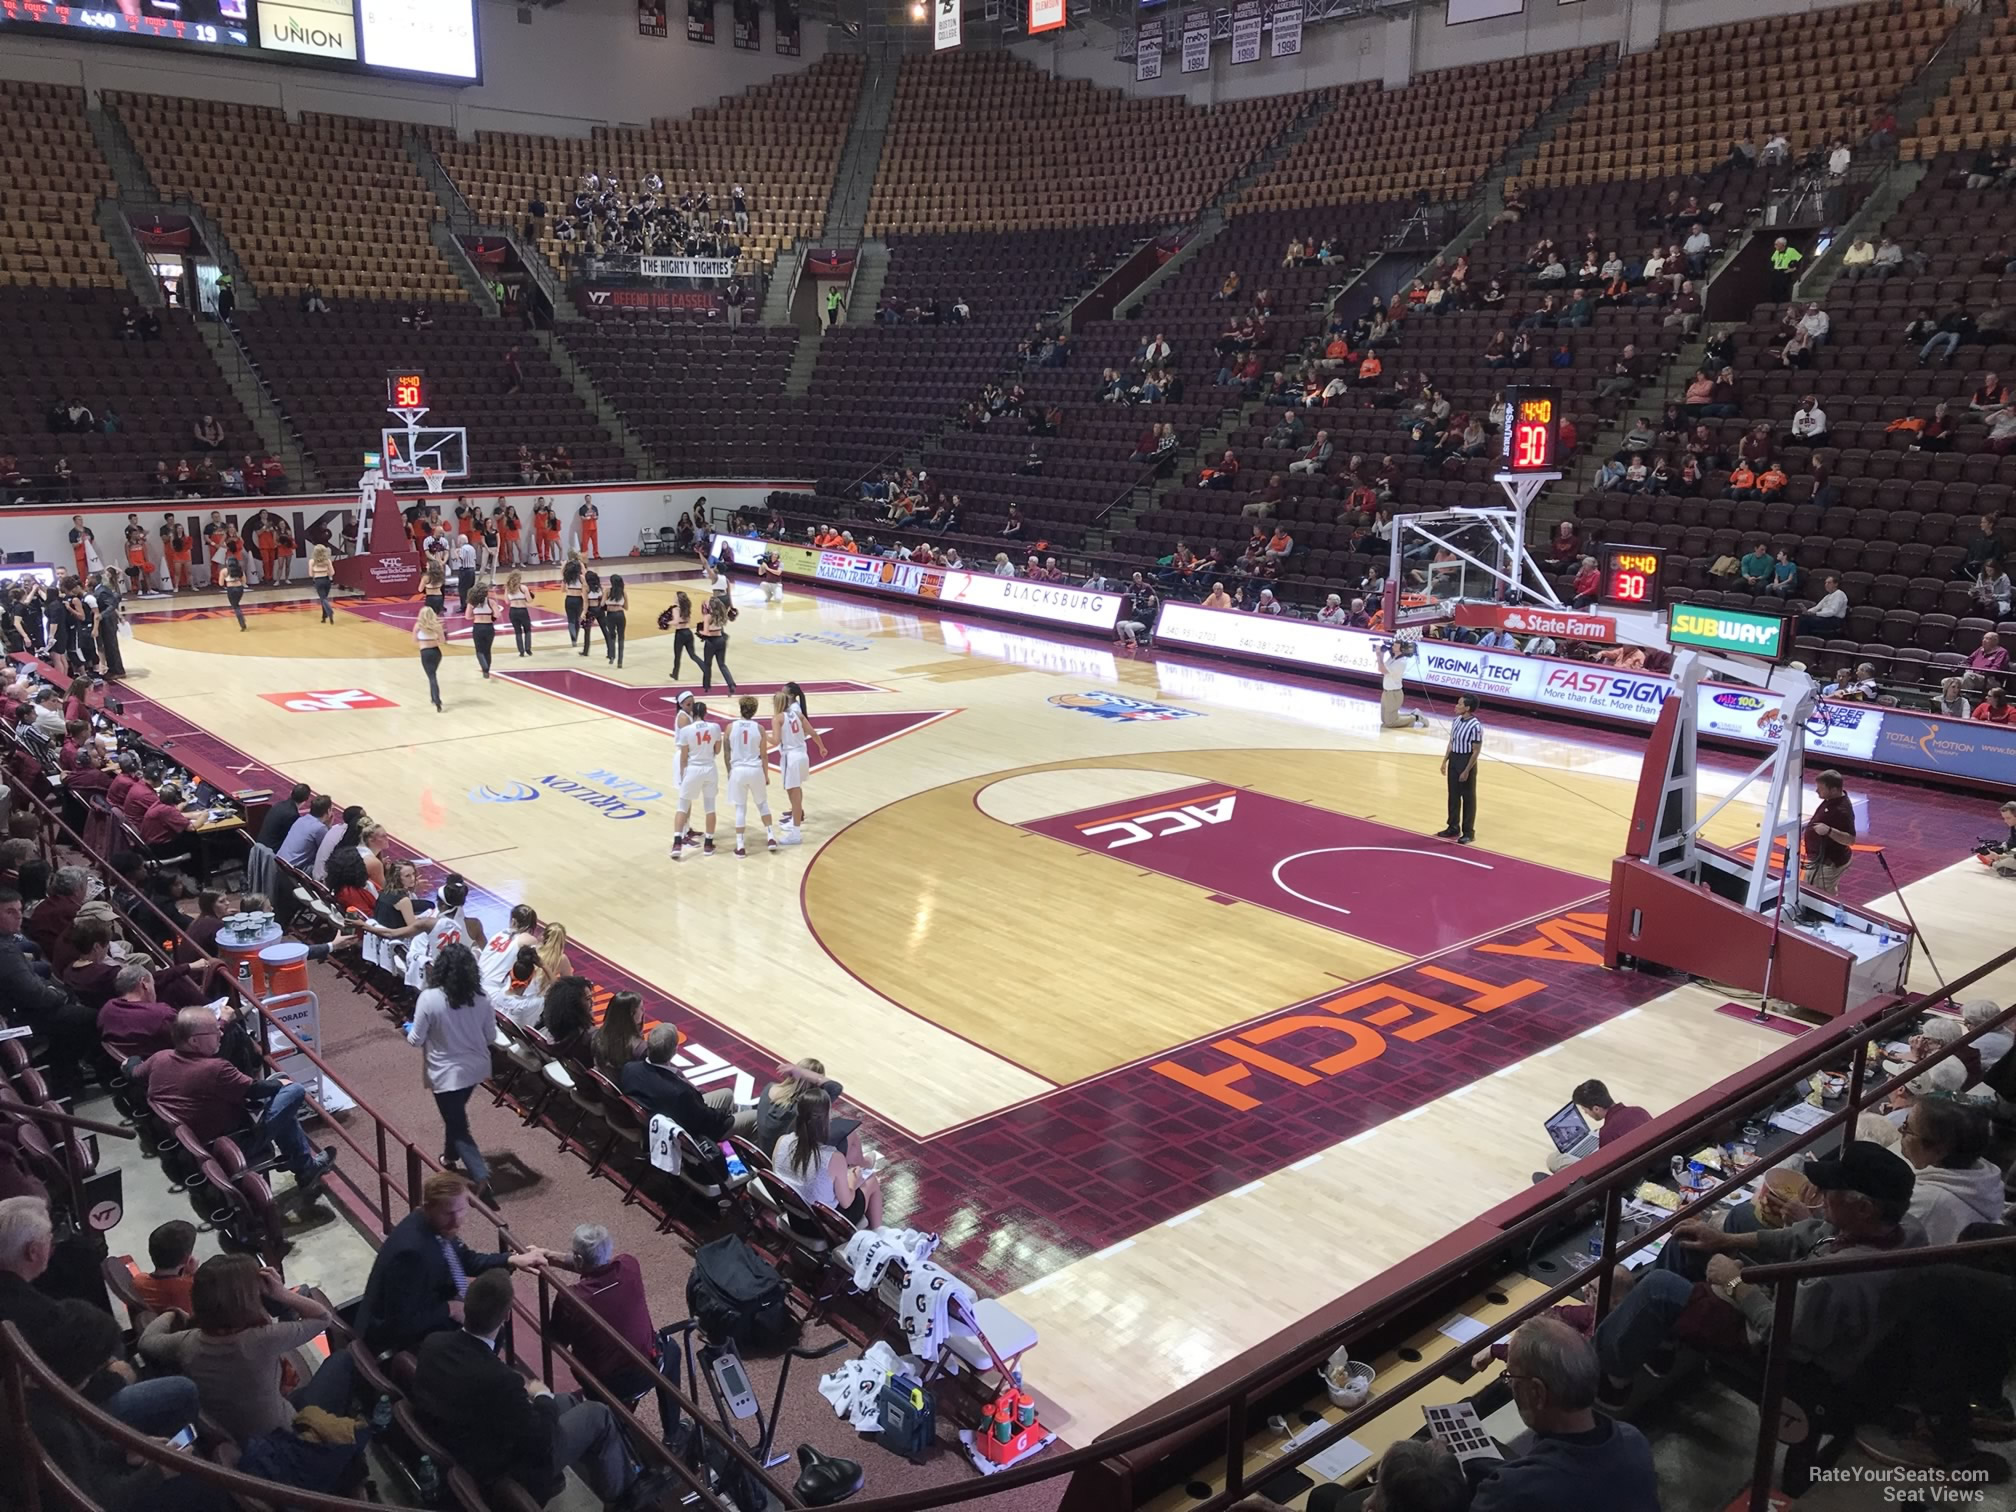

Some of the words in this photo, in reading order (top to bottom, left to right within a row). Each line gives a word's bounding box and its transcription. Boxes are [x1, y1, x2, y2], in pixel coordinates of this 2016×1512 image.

[24, 2, 47, 13] FOULS
[55, 5, 70, 16] PER
[125, 14, 140, 24] POS
[144, 16, 168, 27] FOULS
[172, 20, 186, 29] TOL
[32, 12, 40, 22] 3
[80, 9, 116, 29] 4:40
[938, 18, 957, 31] BOSTON
[195, 24, 217, 43] 19
[273, 22, 342, 48] UNION
[938, 28, 957, 41] COLLEGE
[1237, 47, 1256, 61] 1998
[1277, 39, 1297, 54] 1998
[1187, 57, 1205, 71] 1994
[642, 259, 658, 274] THE
[661, 260, 690, 275] HIGHTY
[692, 260, 729, 275] TIGHTIES
[588, 291, 611, 305] VT
[613, 292, 648, 306] DEFEND
[650, 293, 669, 307] THE
[671, 294, 714, 308] CASSELL
[399, 376, 420, 387] 4:40
[398, 387, 418, 405] 30
[1525, 401, 1551, 423] 4:40
[1517, 426, 1547, 465] 30
[1620, 555, 1656, 574] 4:40
[818, 566, 849, 581] MARTIN
[849, 570, 876, 586] TRAVEL
[1618, 575, 1645, 599] 30
[1003, 582, 1103, 612] BLACKSBURG
[1672, 615, 1779, 645] SUBWAY
[1427, 655, 1479, 676] VIRGINIA
[1488, 665, 1521, 682] TECH
[1425, 673, 1439, 684] IMG
[1440, 676, 1471, 689] SPORTS
[1471, 681, 1511, 695] NETWORK
[1547, 669, 1675, 705] FASTSIGN
[285, 689, 377, 712] 2K
[1543, 688, 1567, 700] More
[1567, 691, 1587, 703] than
[1588, 693, 1608, 707] fast.
[1609, 699, 1633, 711] More
[1634, 701, 1656, 715] than
[1823, 705, 1865, 718] SUPER
[695, 730, 712, 745] 14
[742, 730, 748, 744] 1
[1886, 731, 1917, 744] TOTAL
[1932, 740, 1975, 753] MOTION
[577, 768, 664, 802] CLINIC
[534, 774, 647, 820] CARILION
[1081, 795, 1237, 849] ACC
[1149, 965, 1547, 1111] TECH
[93, 1204, 116, 1222] VT
[930, 1277, 946, 1290] G
[916, 1294, 926, 1313] G
[904, 1316, 915, 1334] G
[859, 1380, 876, 1395] G
[1016, 1435, 1028, 1450] G
